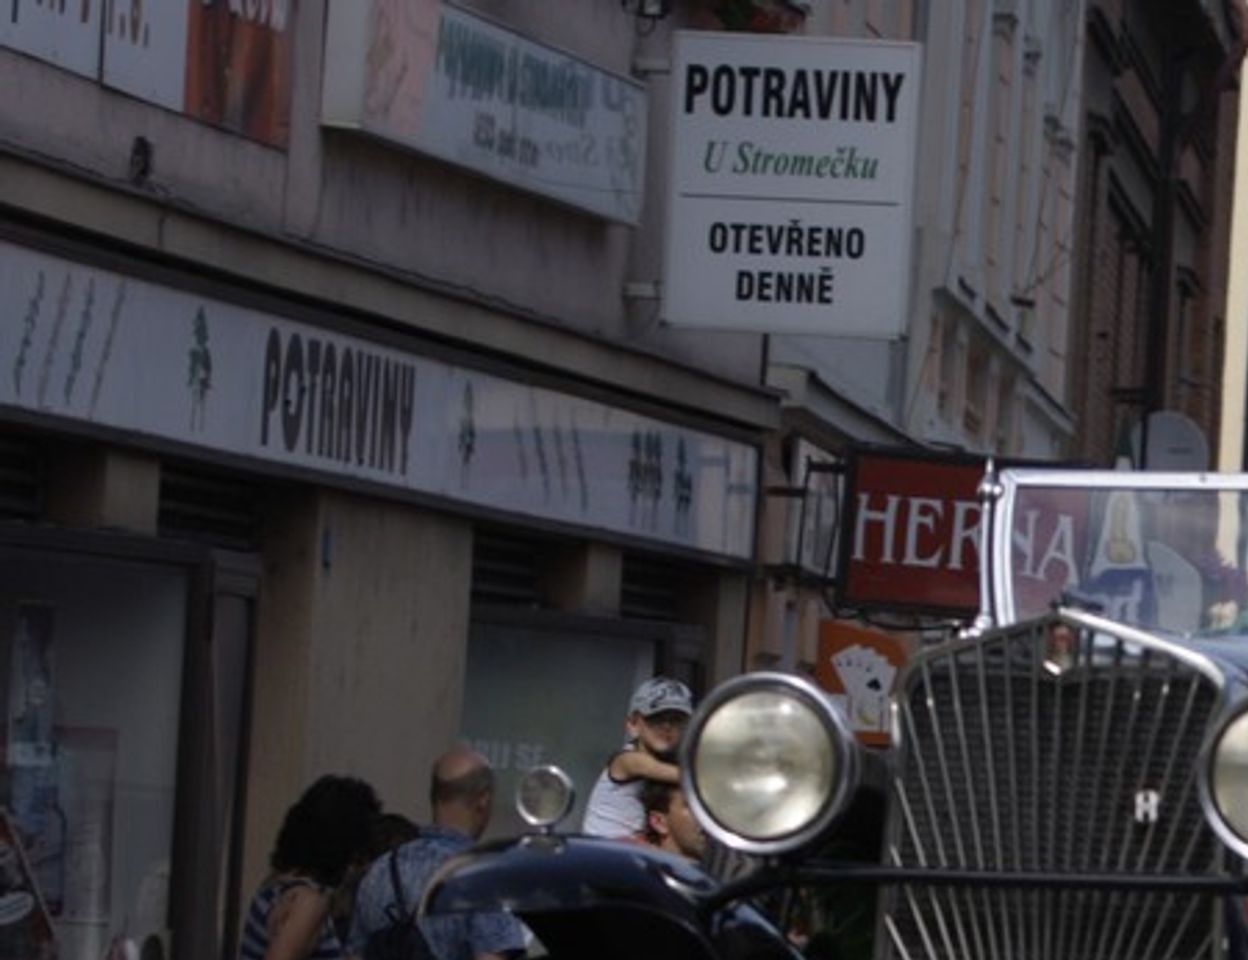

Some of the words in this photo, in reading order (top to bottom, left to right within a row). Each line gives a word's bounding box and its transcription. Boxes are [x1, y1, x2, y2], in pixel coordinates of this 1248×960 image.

[684, 63, 905, 124] POTRAVINY
[704, 140, 728, 174] U
[733, 141, 878, 180] Stromečku
[709, 218, 866, 260] OTEVŘENO
[735, 266, 835, 305] DENNĚ
[260, 327, 415, 477] POTRAVINY
